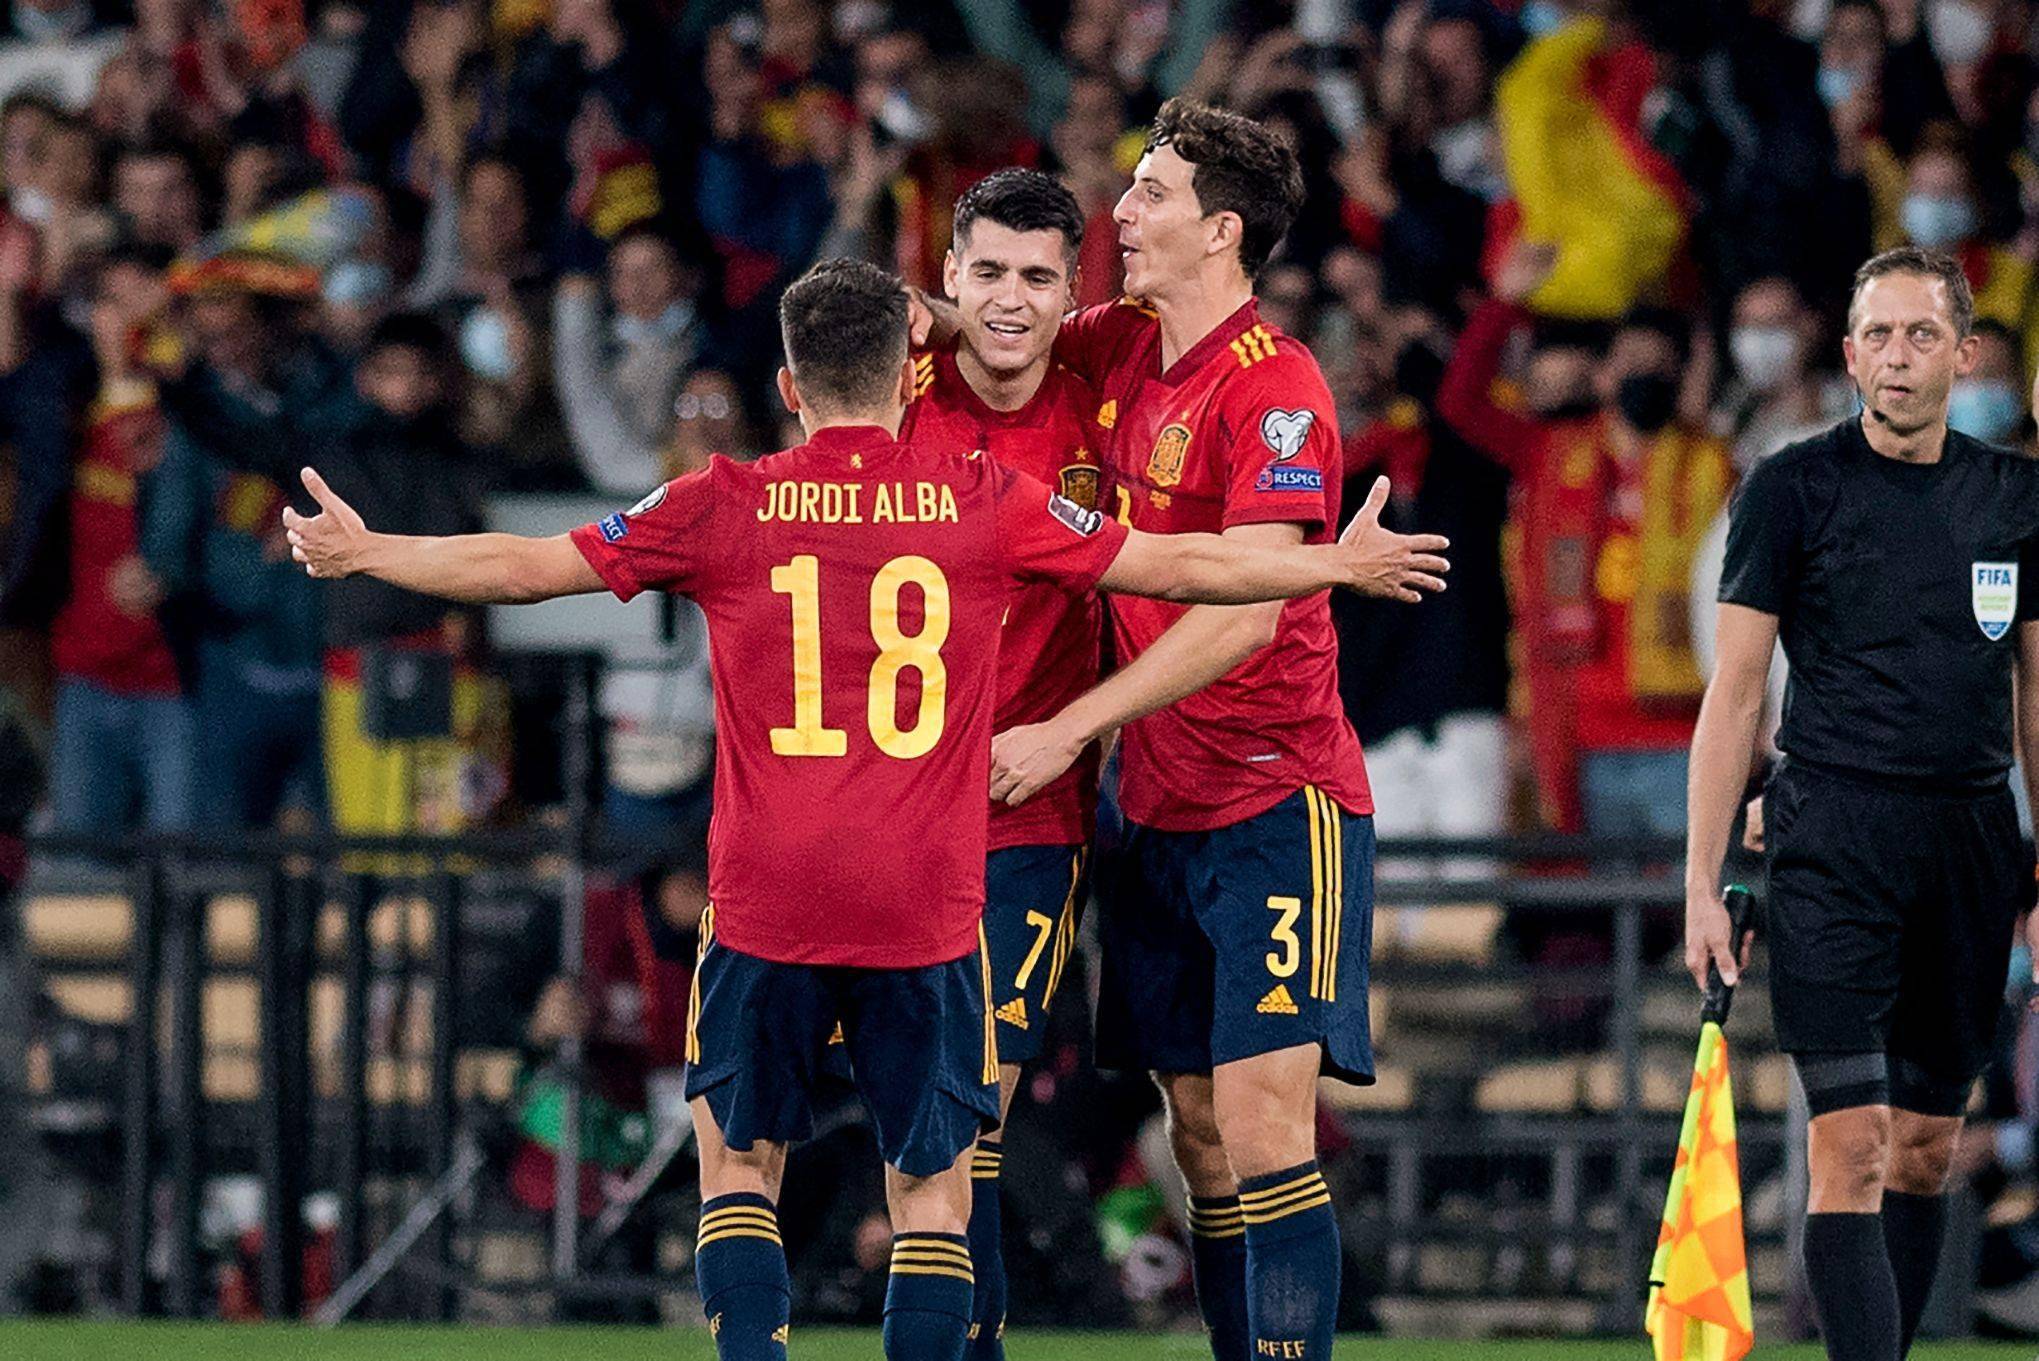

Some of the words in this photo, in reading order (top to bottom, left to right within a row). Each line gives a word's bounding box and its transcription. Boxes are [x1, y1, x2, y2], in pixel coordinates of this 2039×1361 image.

[1274, 473, 1321, 486] RESPECT
[757, 481, 863, 524] JORDI
[872, 482, 959, 523] ALBA
[1977, 569, 2011, 585] FIFA
[769, 555, 950, 759] 18
[1014, 909, 1052, 990] 7
[1265, 896, 1301, 978] 3
[1257, 1338, 1305, 1359] RFEF
